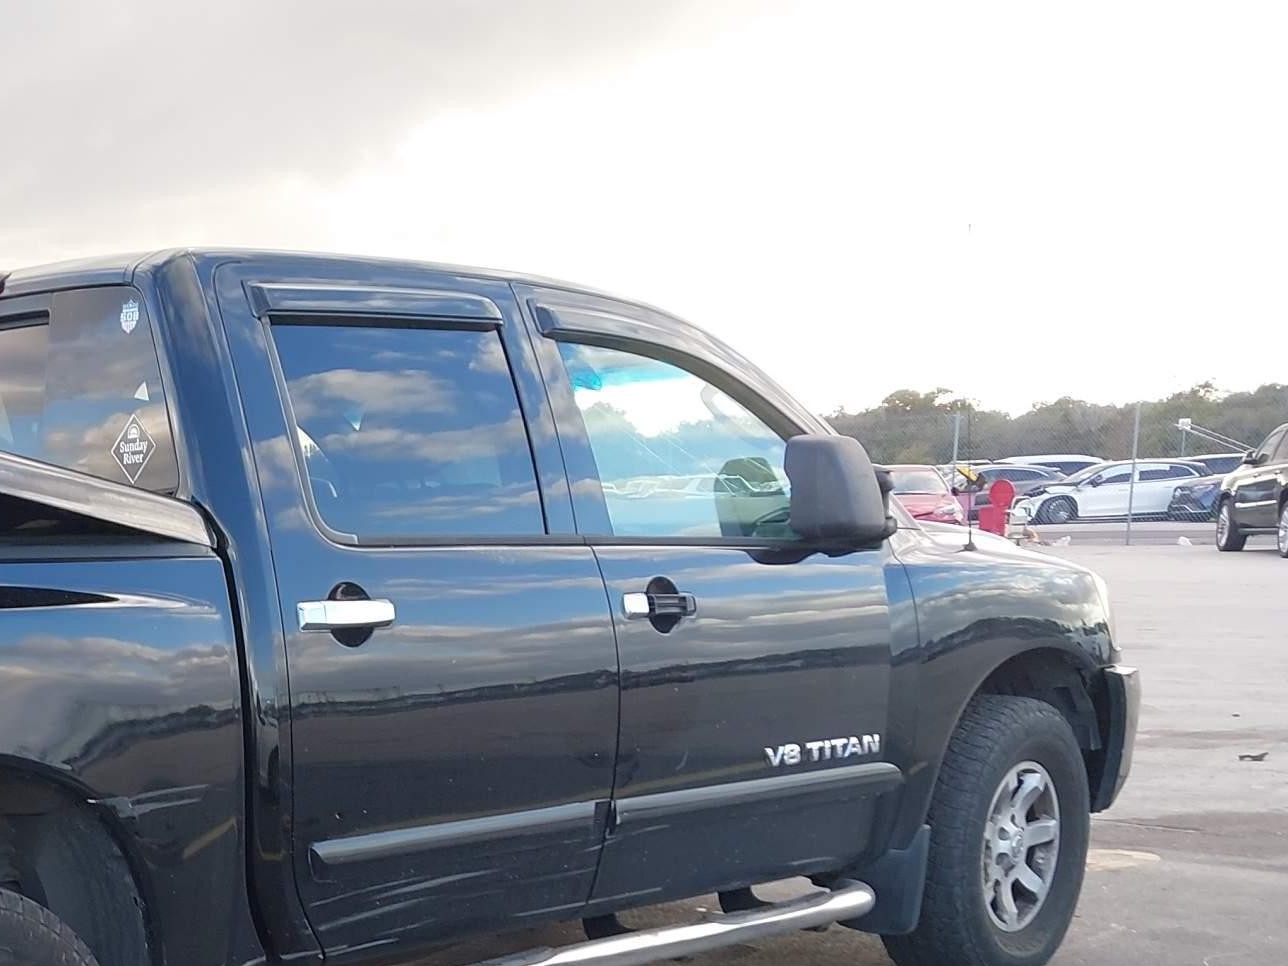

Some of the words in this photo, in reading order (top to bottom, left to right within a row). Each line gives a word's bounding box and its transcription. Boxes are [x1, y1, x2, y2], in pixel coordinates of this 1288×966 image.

[119, 438, 148, 454] Sunday
[123, 452, 144, 465] River
[764, 743, 801, 767] V8
[805, 733, 880, 762] TITAN
